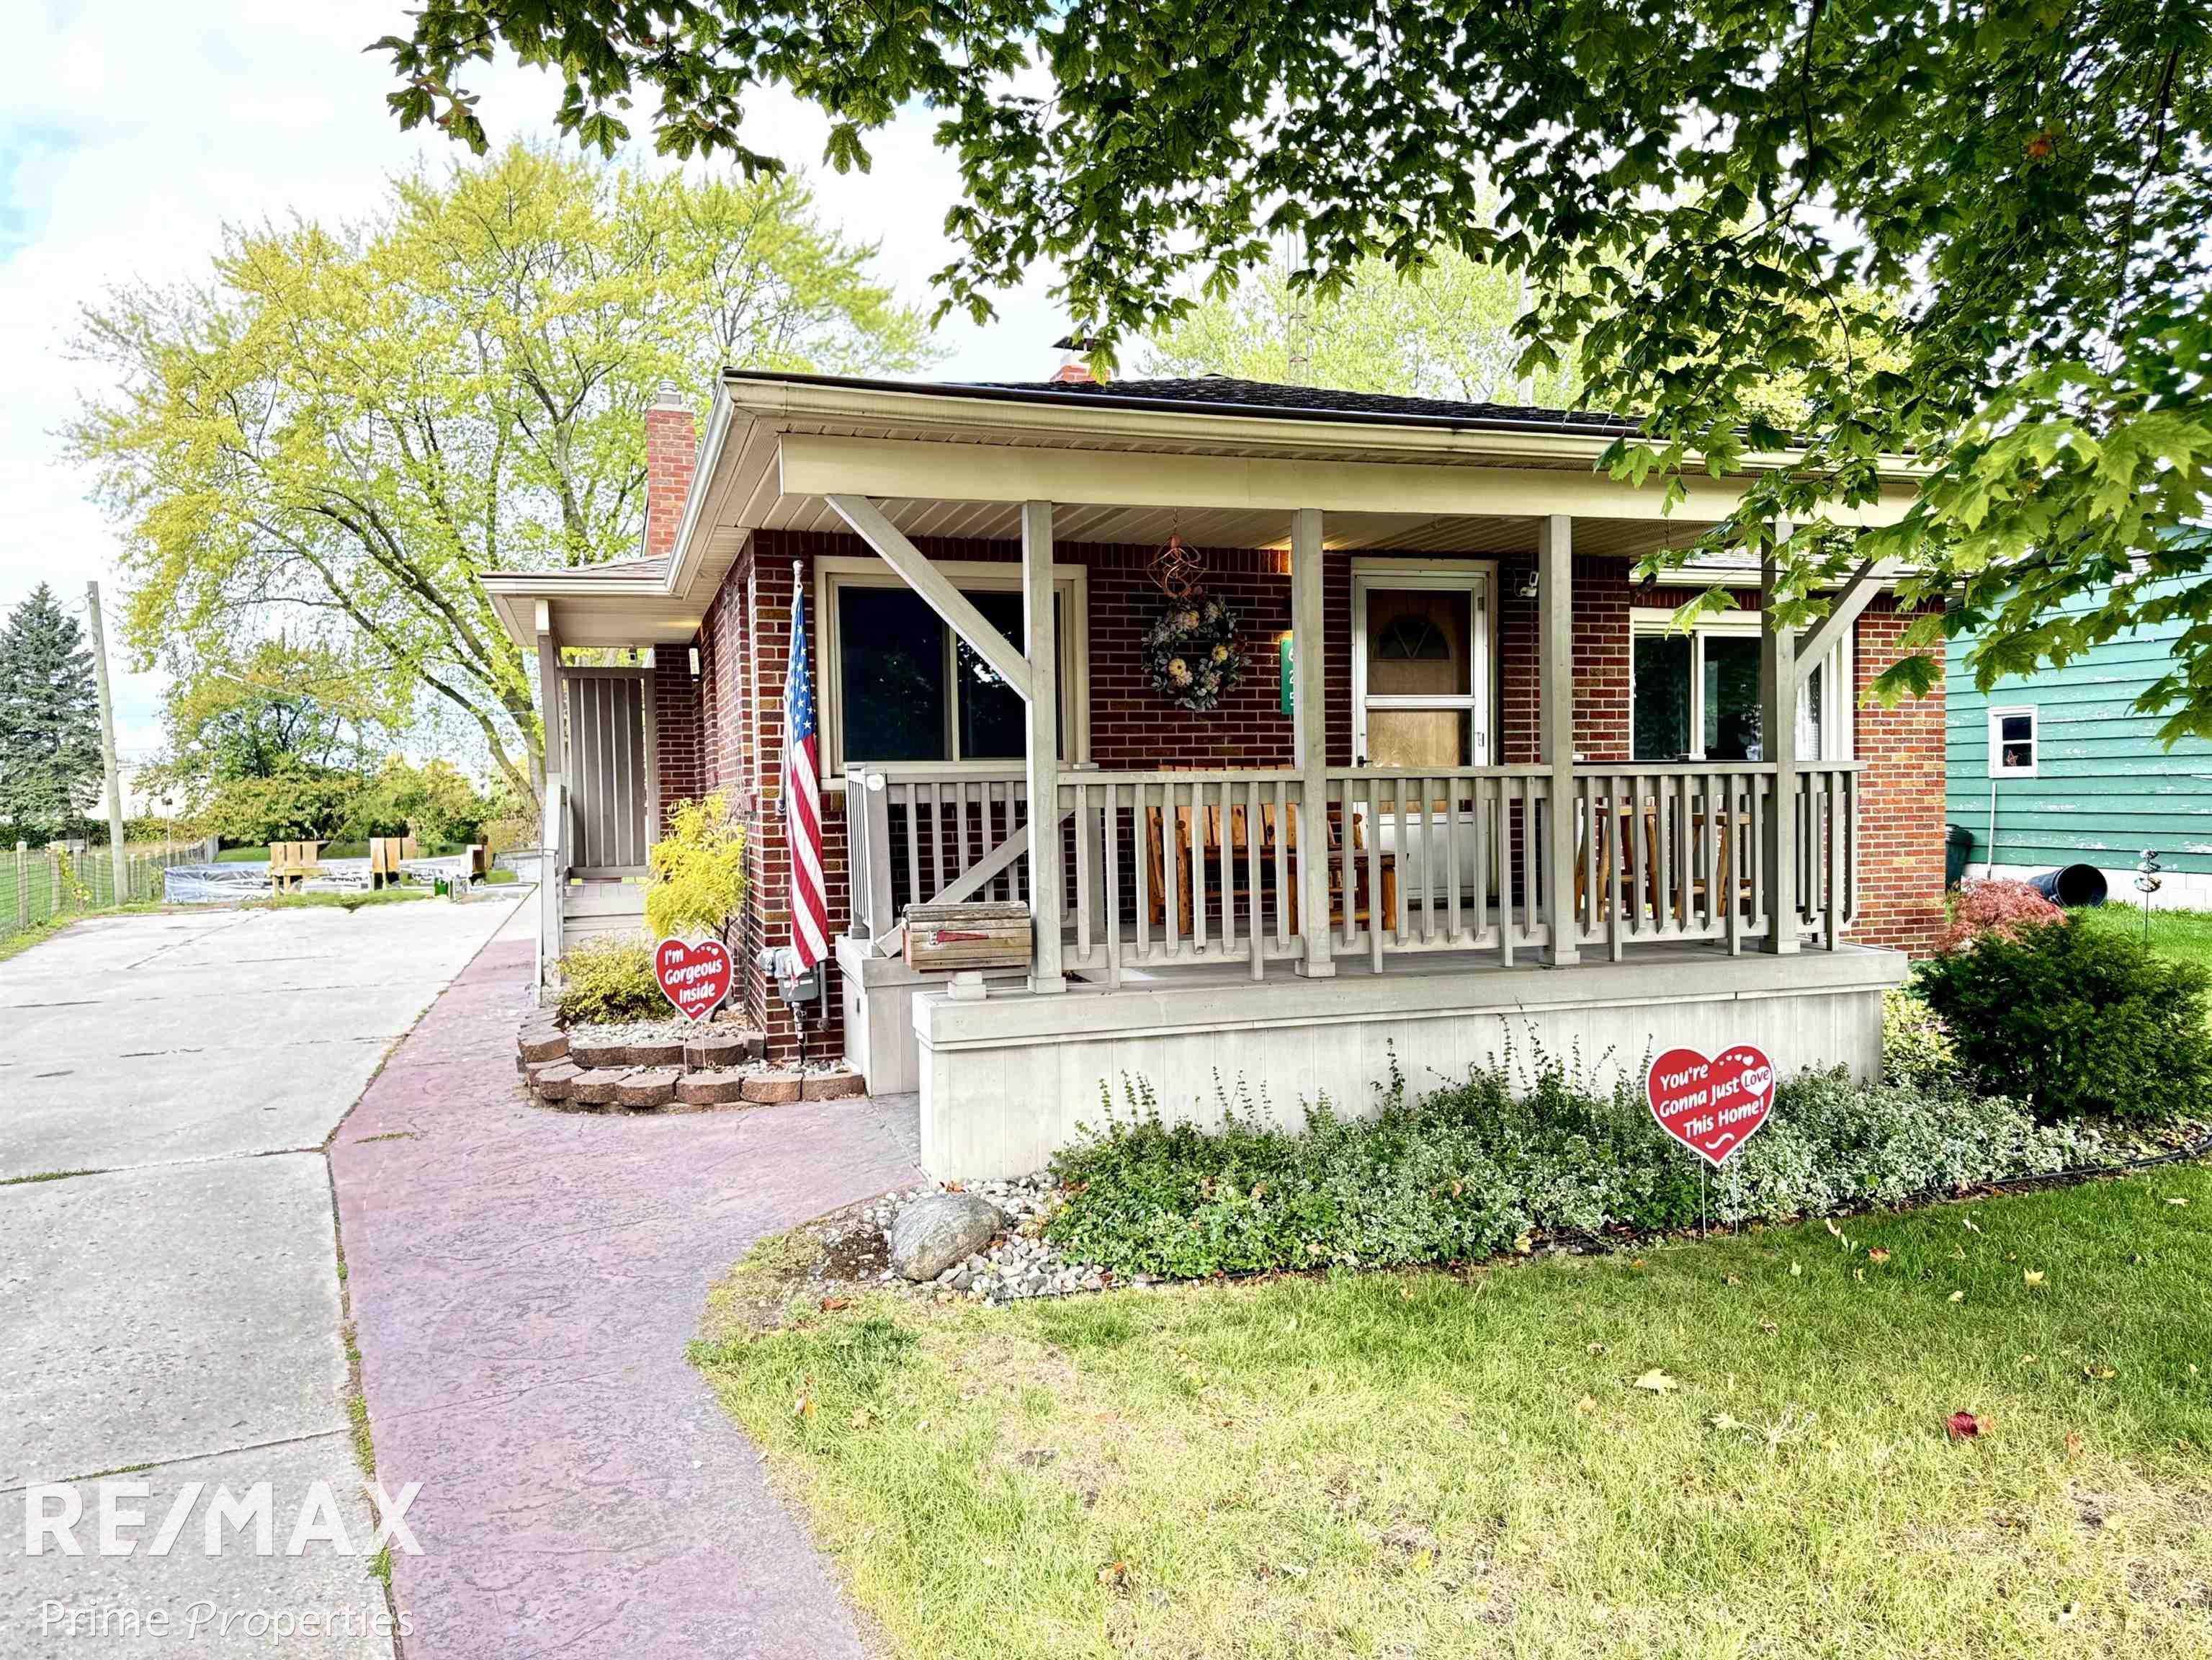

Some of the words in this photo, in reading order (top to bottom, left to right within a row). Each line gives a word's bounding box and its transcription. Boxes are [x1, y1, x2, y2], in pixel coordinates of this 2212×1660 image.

[665, 949, 684, 965] I'm
[665, 959, 722, 985] Gorgeous
[679, 981, 715, 1004] Inside
[1660, 1064, 1709, 1092] You're
[1660, 1089, 1707, 1117] Gonna
[1710, 1076, 1739, 1107] Just
[1744, 1068, 1770, 1087] Love
[1683, 1115, 1714, 1138] This
[1718, 1096, 1765, 1127] Home!
